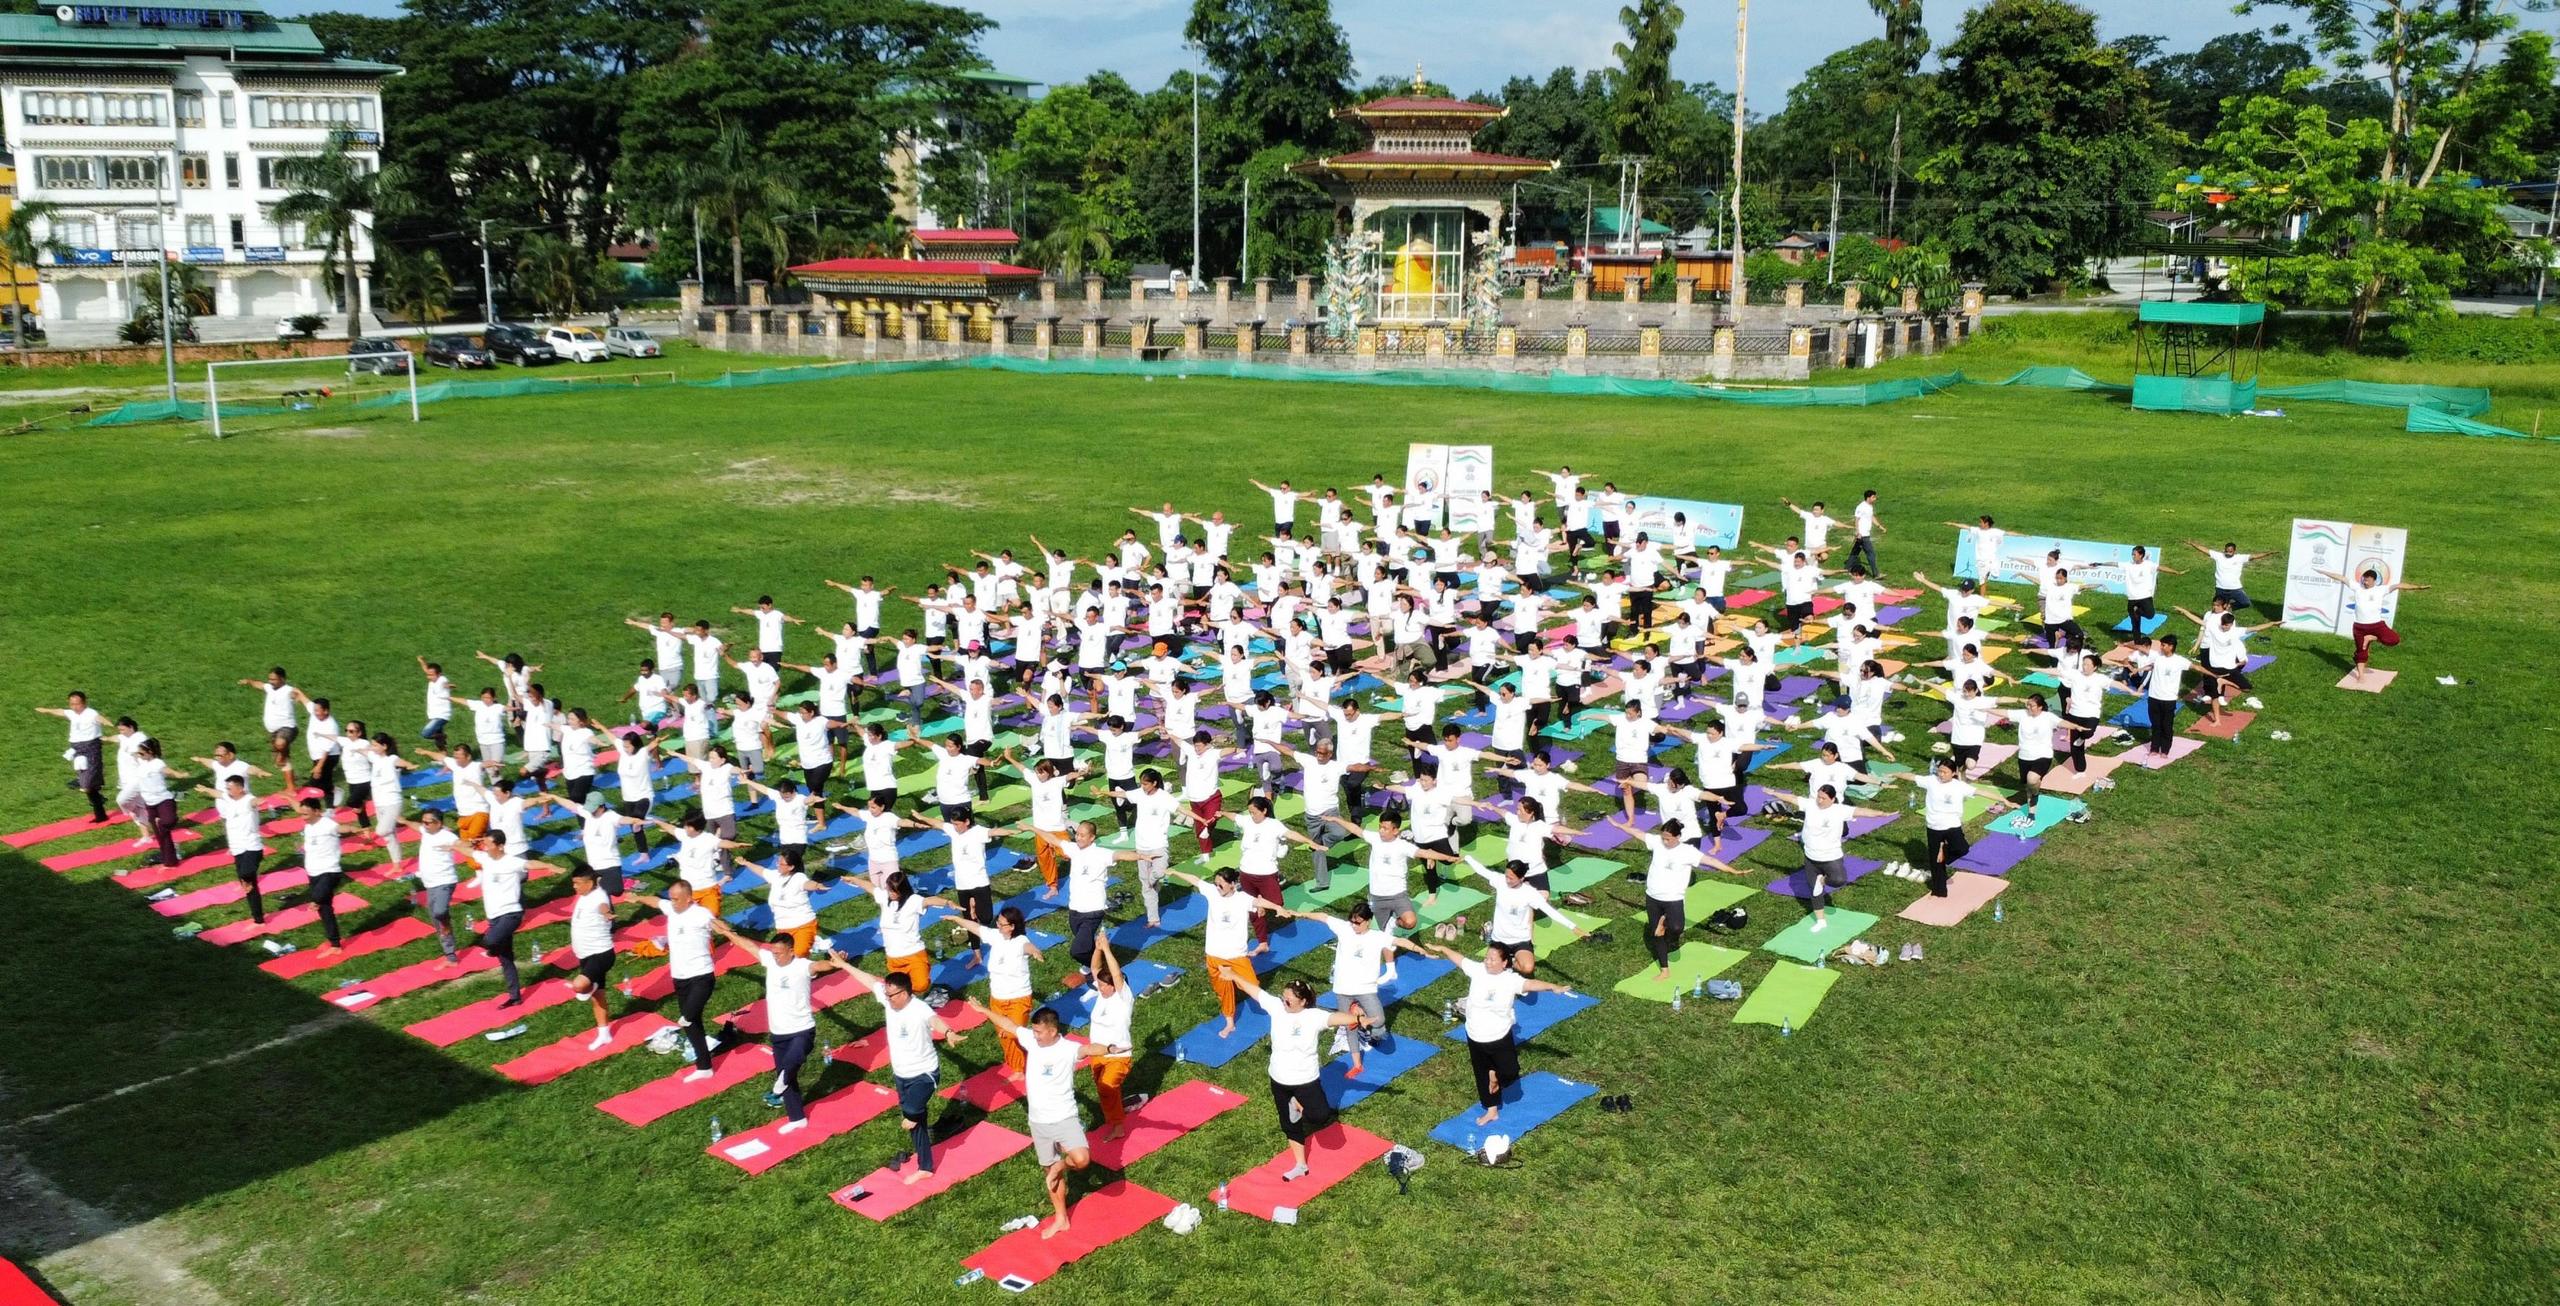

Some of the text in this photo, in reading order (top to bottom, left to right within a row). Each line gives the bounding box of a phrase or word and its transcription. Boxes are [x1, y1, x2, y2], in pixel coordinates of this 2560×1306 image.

[74, 7, 128, 22] BHUTAN
[136, 9, 209, 25] INSURANCE
[111, 251, 159, 261] SAMSUN
[2000, 560, 2040, 571] Interna
[2069, 568, 2088, 577] Day
[2091, 570, 2102, 578] of
